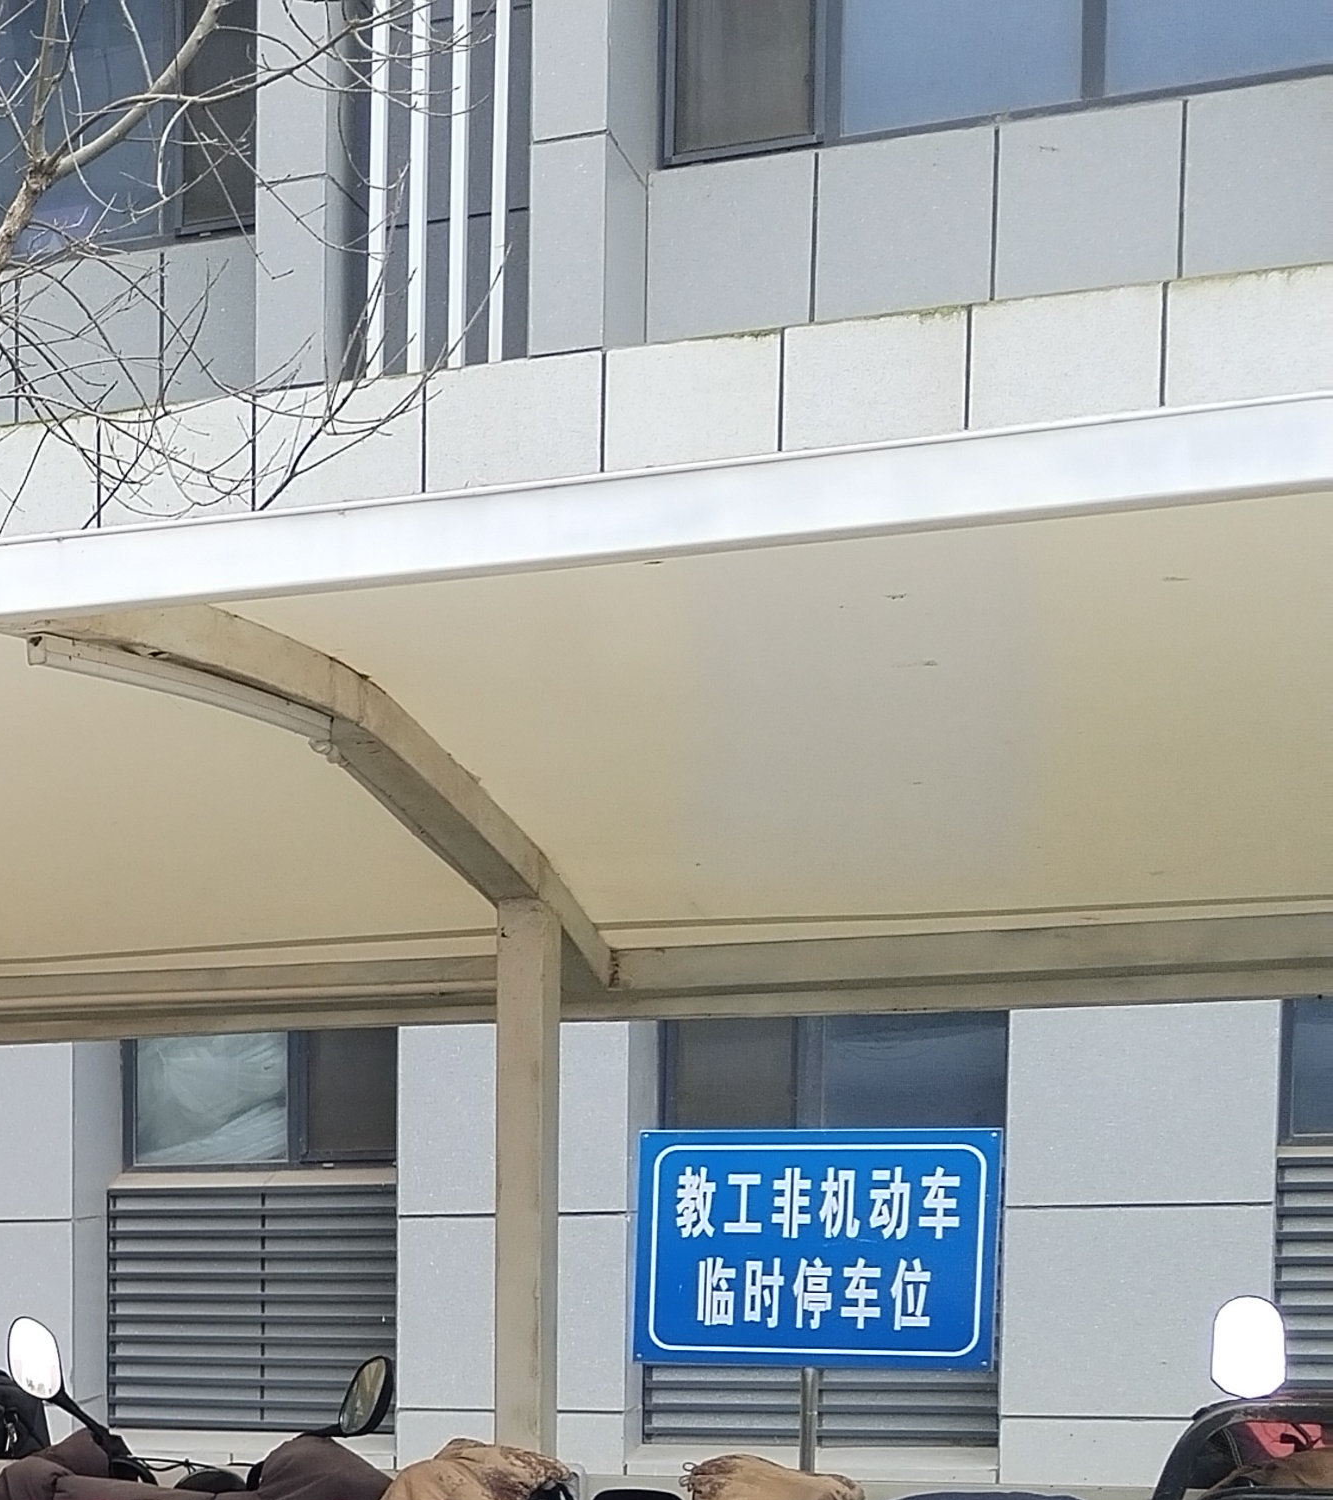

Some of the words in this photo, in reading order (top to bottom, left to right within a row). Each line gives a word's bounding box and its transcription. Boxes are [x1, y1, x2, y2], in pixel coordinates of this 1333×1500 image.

[675, 1166, 961, 1240] 教工非机动车
[696, 1256, 932, 1331] 临时停车位
